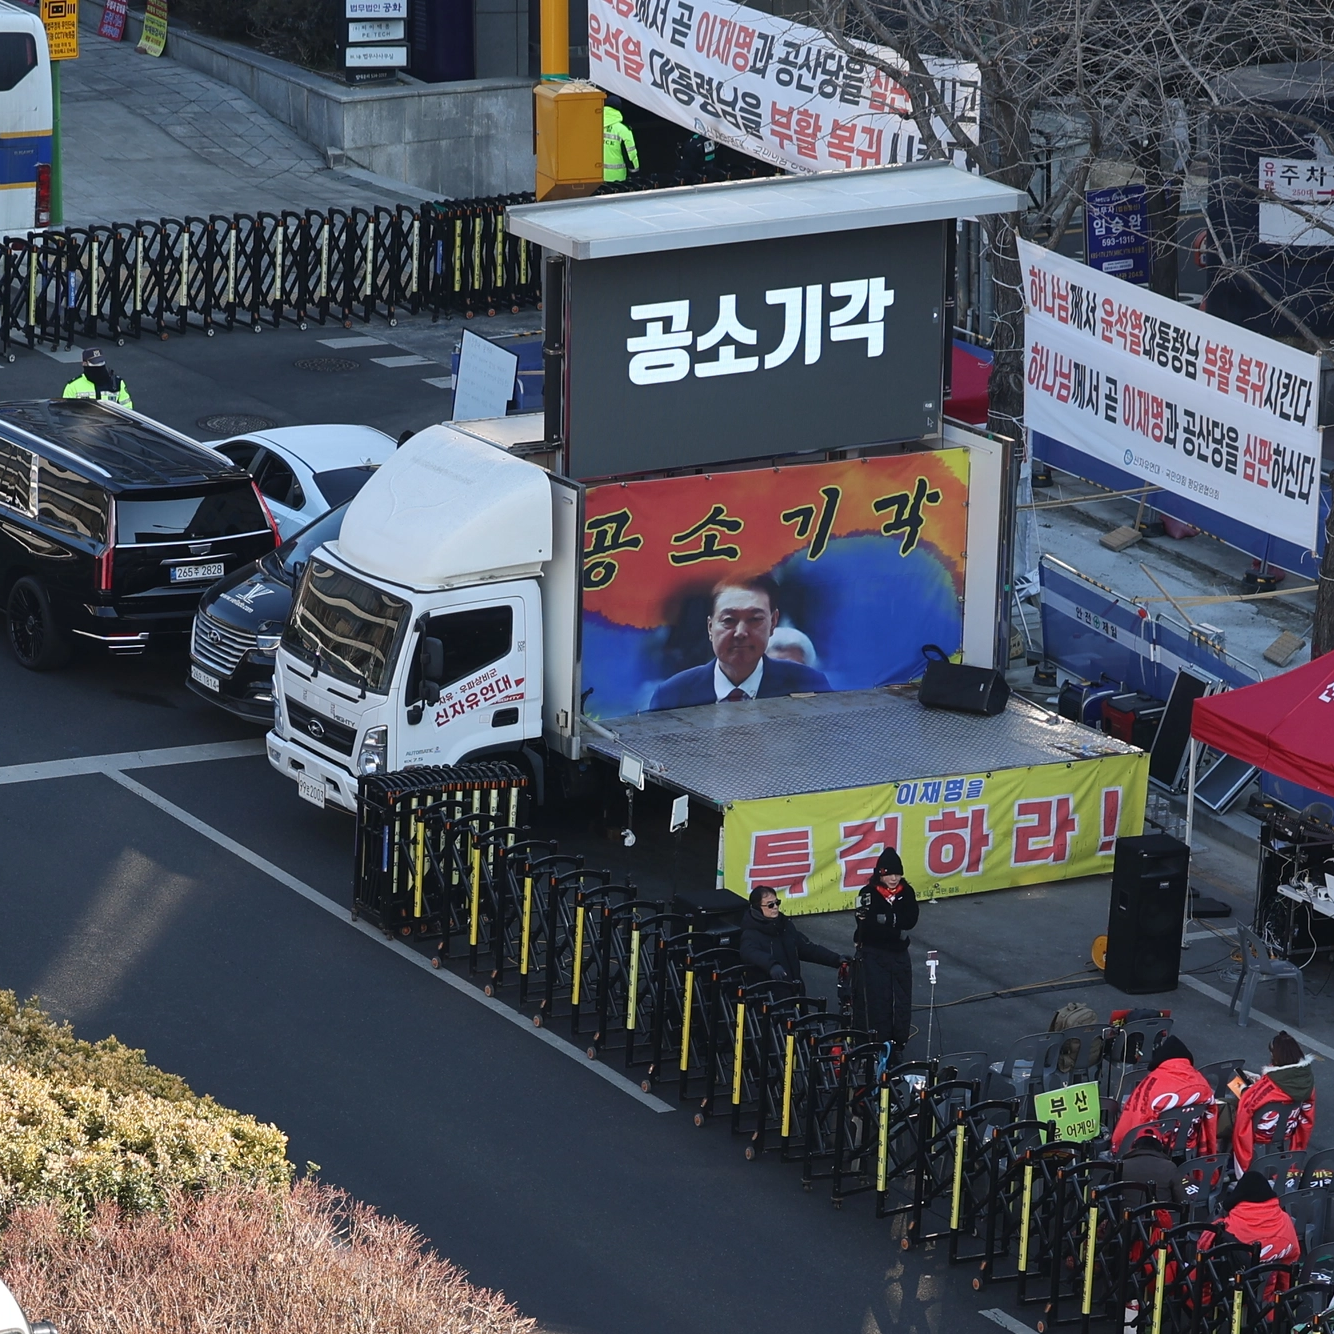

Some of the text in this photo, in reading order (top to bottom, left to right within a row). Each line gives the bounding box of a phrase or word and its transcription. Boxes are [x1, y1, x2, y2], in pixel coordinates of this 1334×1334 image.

[350, 4, 380, 13] 법무법인
[670, 1, 694, 49] 곧
[696, 11, 775, 80] 이재명과
[588, 13, 644, 83] 윤석열
[649, 48, 763, 141] 대통령님을
[771, 100, 822, 160] 부활
[1102, 235, 1135, 246] 593-1315
[627, 276, 894, 386] 공소기각
[1029, 265, 1313, 426] 하나님께서 윤석열대통령님 부활 복귀시킨다
[1028, 342, 1316, 505] 하나님께서 곧 이재명과 공산당을 심판하신다
[583, 476, 943, 590] 공소기각
[201, 564, 223, 576] 2828
[1075, 606, 1092, 626] 안전
[459, 668, 498, 694] 우파상비군
[434, 674, 513, 728] 신자유연대
[405, 748, 433, 757] AUTOMATIC
[895, 778, 985, 806] 이재명을
[1049, 1090, 1089, 1118] 부산
[1066, 1118, 1095, 1139] 어게인
